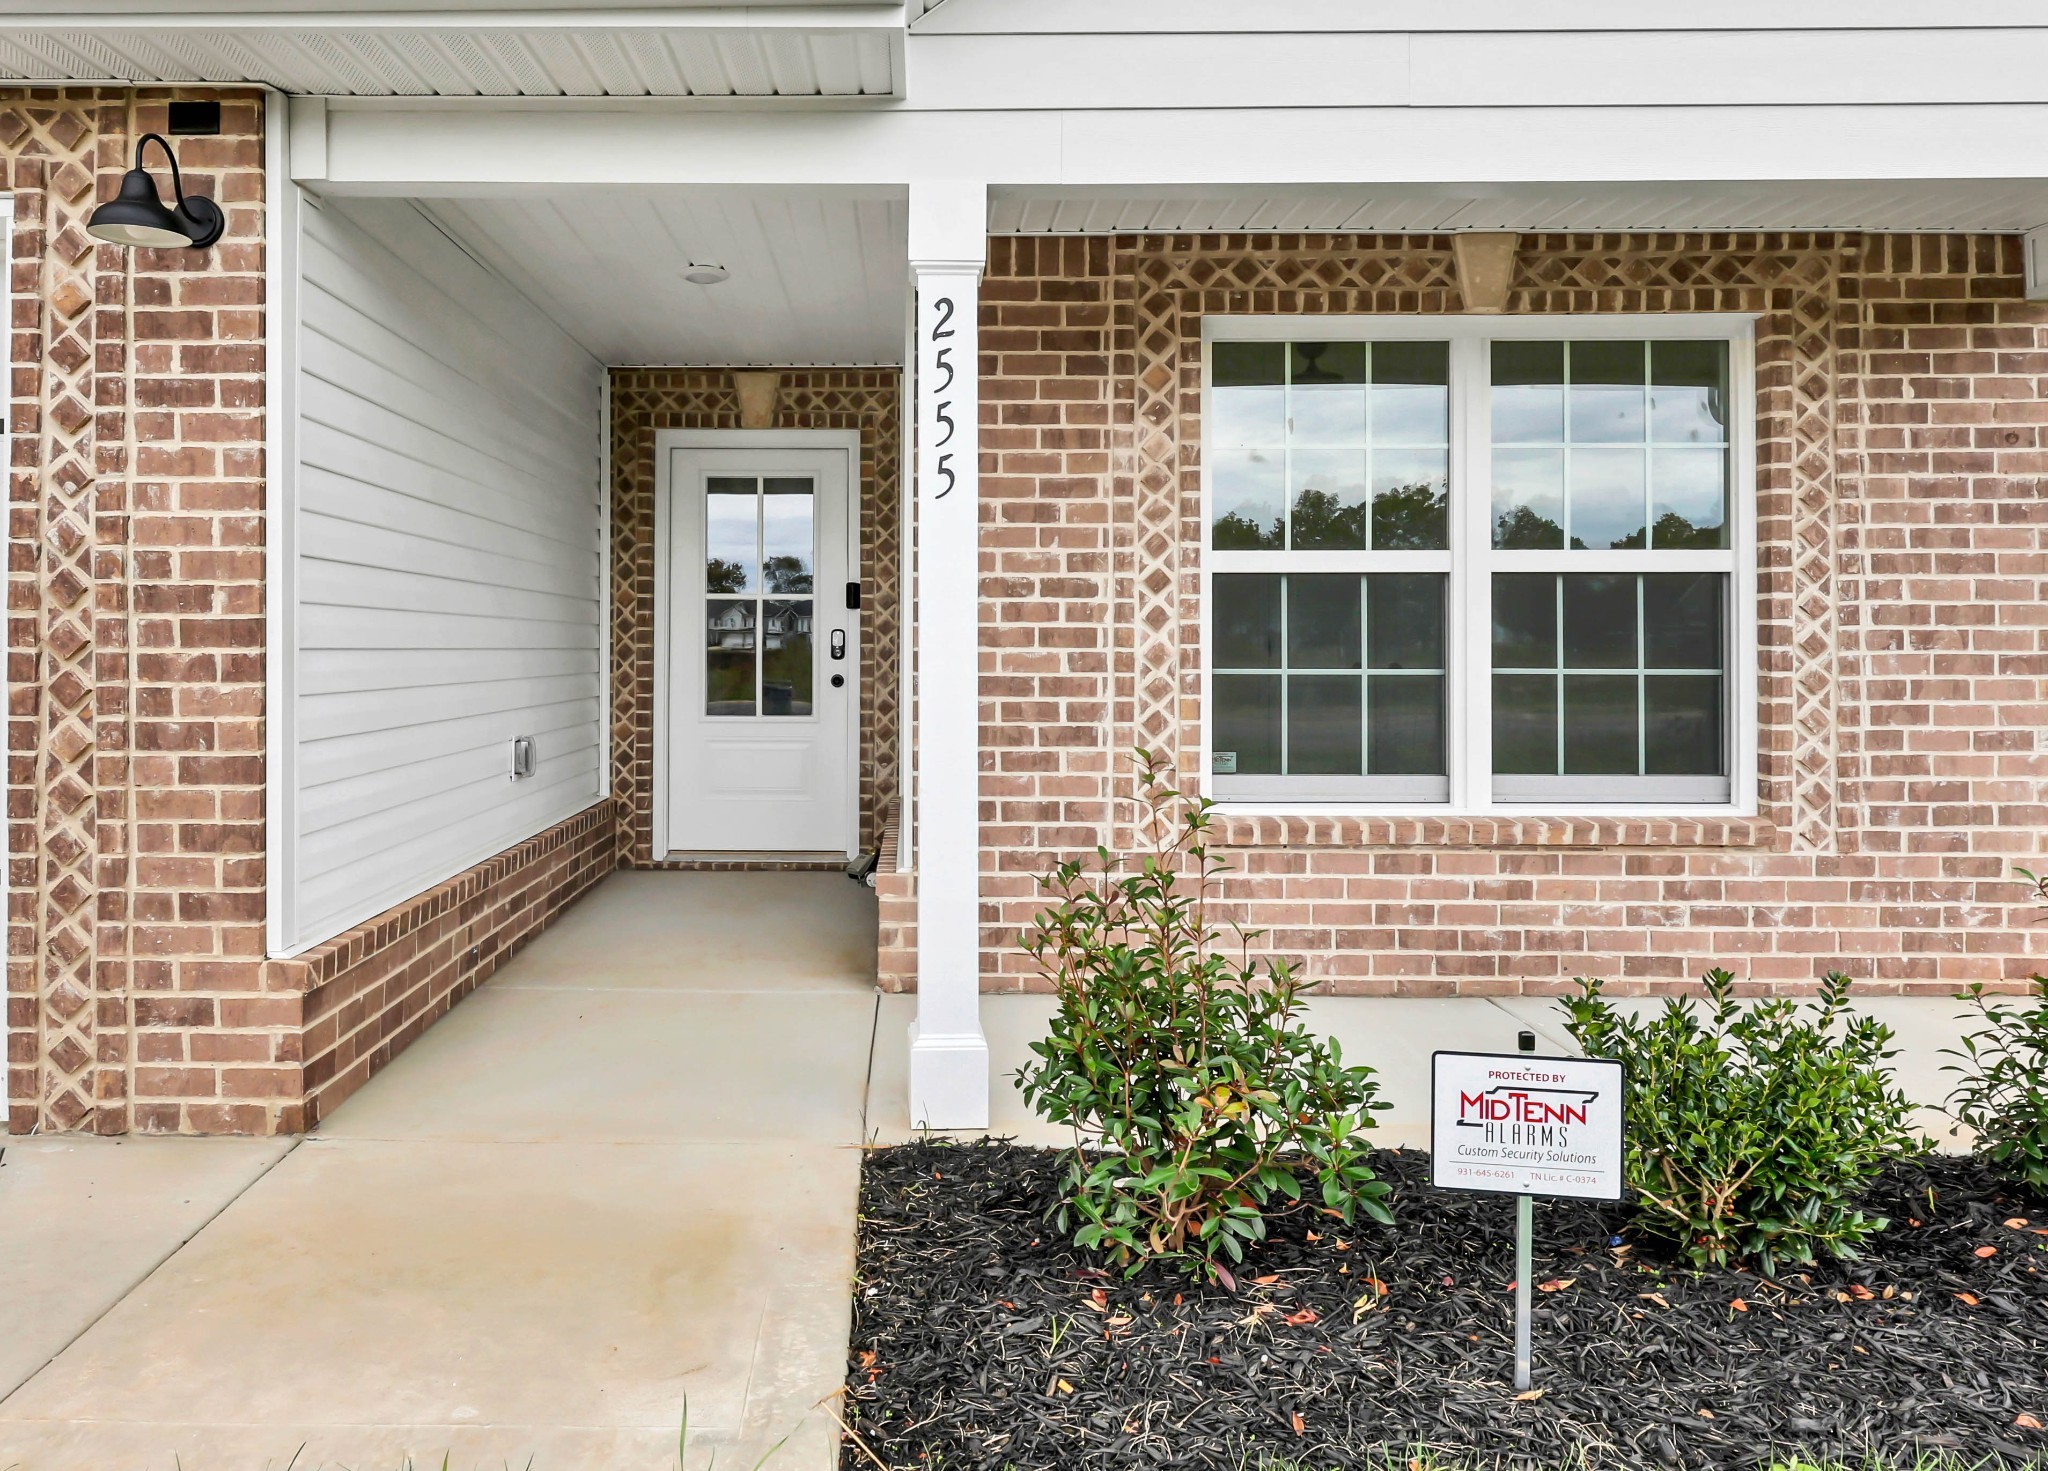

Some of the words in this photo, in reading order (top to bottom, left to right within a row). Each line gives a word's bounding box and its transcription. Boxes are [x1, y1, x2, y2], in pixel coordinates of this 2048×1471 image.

[932, 297, 956, 499] 2555
[1488, 1070, 1549, 1082] PROTECTED
[1552, 1074, 1566, 1083] BY
[1485, 1121, 1568, 1148] ALARMS
[1457, 1144, 1499, 1158] Custom
[1501, 1147, 1544, 1163] Security
[1546, 1150, 1597, 1165] Solutions
[1457, 1168, 1515, 1179] 931-645-6261
[1530, 1172, 1541, 1181] TN
[1543, 1174, 1558, 1182] Lic.
[1566, 1174, 1597, 1184] C-0374
